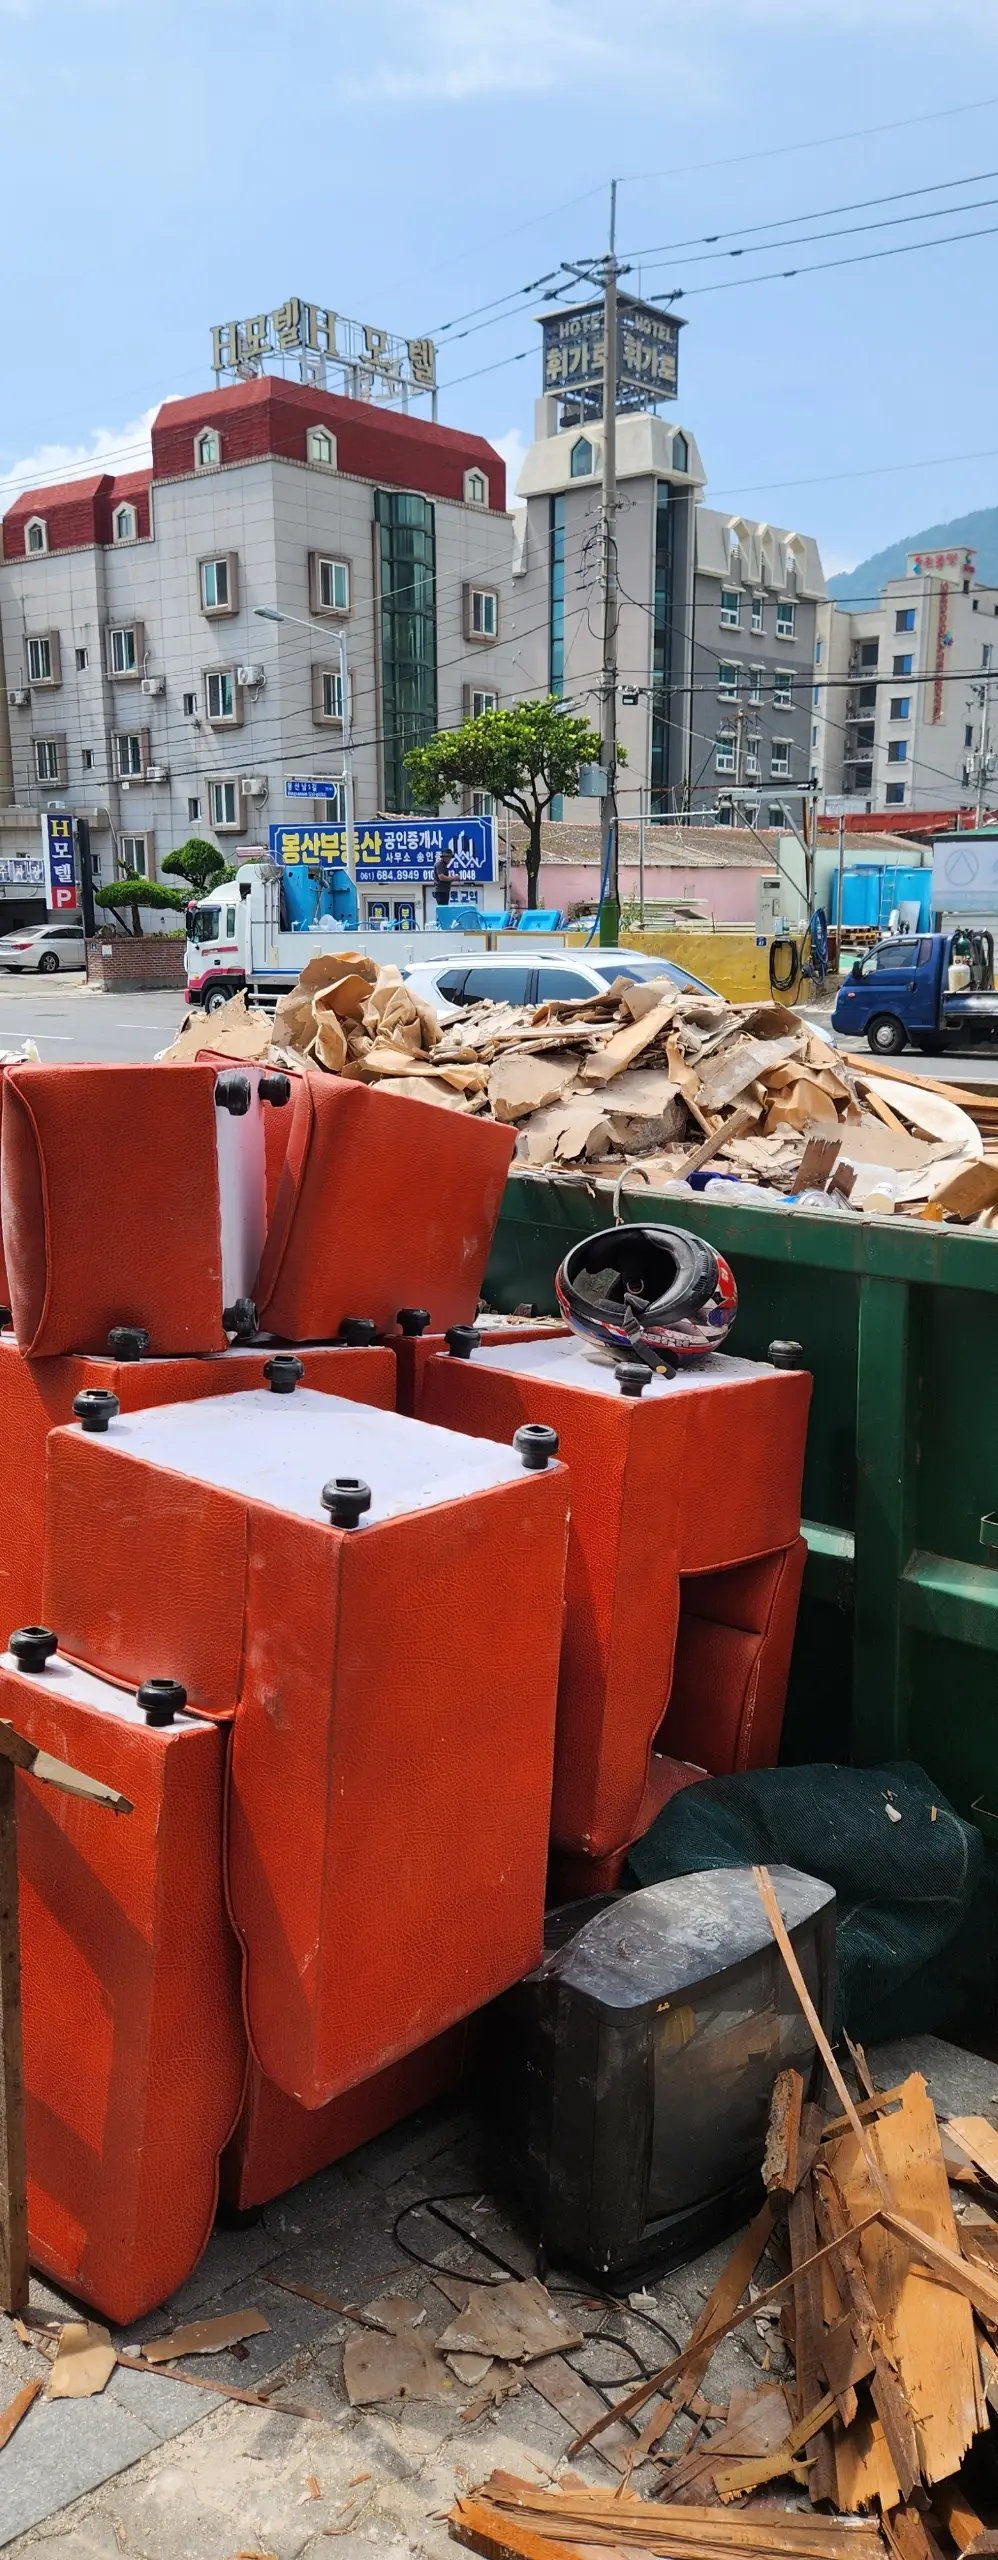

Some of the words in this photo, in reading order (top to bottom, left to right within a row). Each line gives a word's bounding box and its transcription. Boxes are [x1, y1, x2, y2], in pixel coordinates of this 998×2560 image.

[635, 315, 674, 344] HOTEL
[623, 332, 676, 382] 휘가로
[281, 830, 382, 864] 봉산부동산
[384, 830, 443, 850] 공인중개사
[385, 852, 411, 863] 사무소
[360, 872, 375, 881] 061)
[376, 870, 420, 881] 684.8949
[56, 889, 72, 907] P
